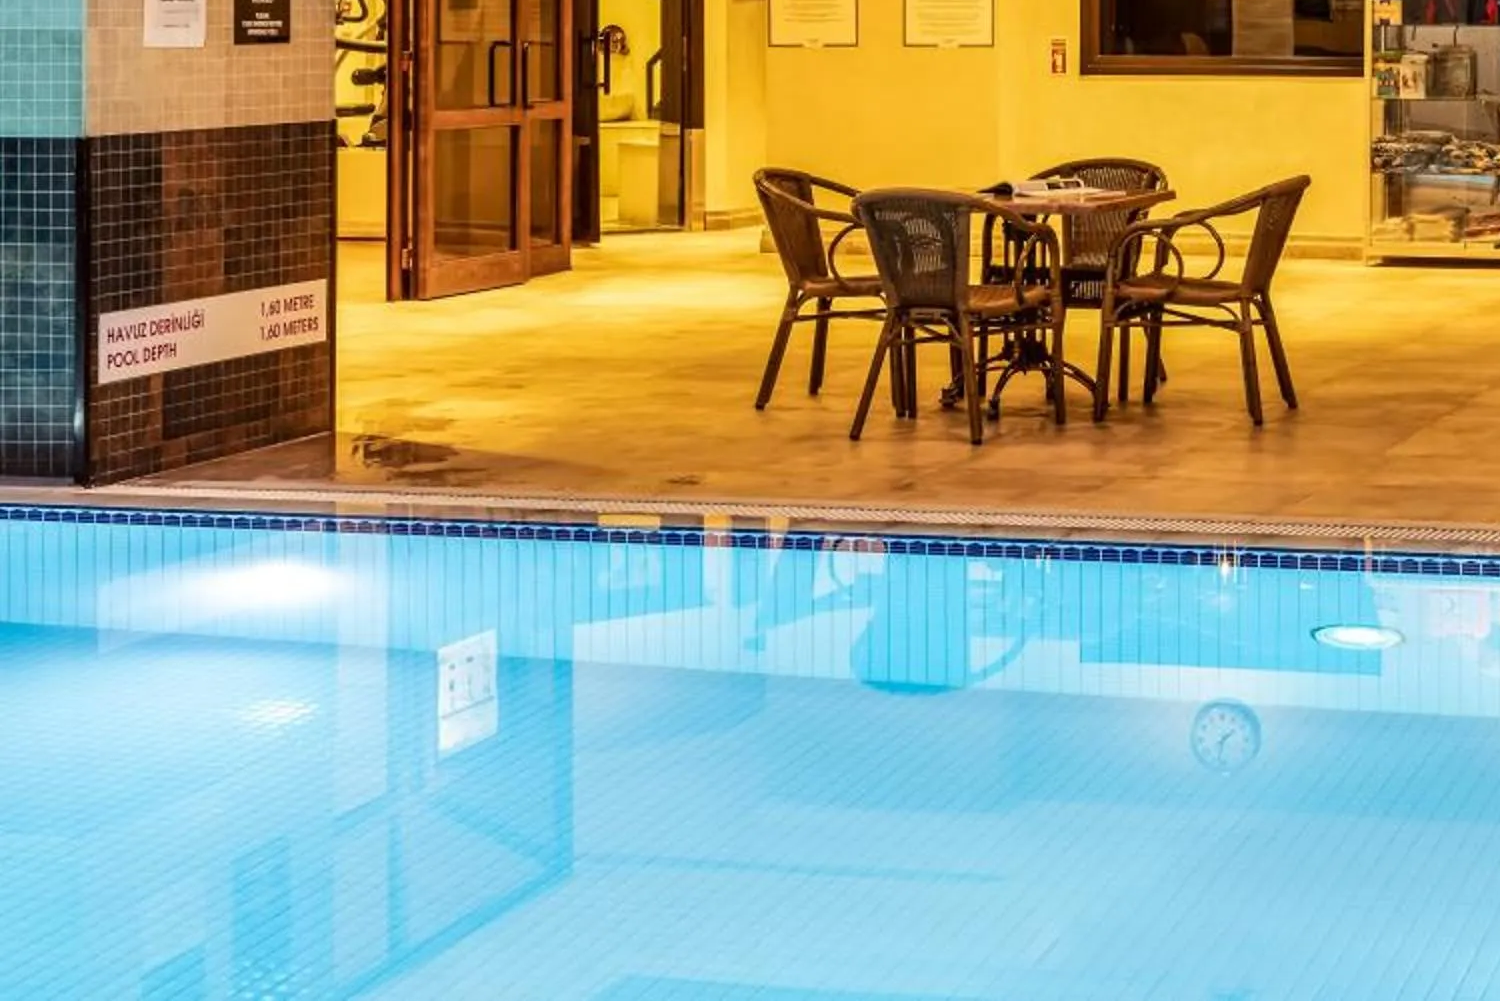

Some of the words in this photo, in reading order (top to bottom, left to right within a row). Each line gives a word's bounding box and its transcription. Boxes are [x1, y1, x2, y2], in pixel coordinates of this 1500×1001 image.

[283, 294, 315, 313] METRE
[107, 322, 147, 344] HAVUZ
[149, 309, 205, 337] DERİNLİĞİ
[283, 317, 319, 337] METERS
[107, 352, 140, 370] POOL
[143, 342, 177, 362] DEPTH
